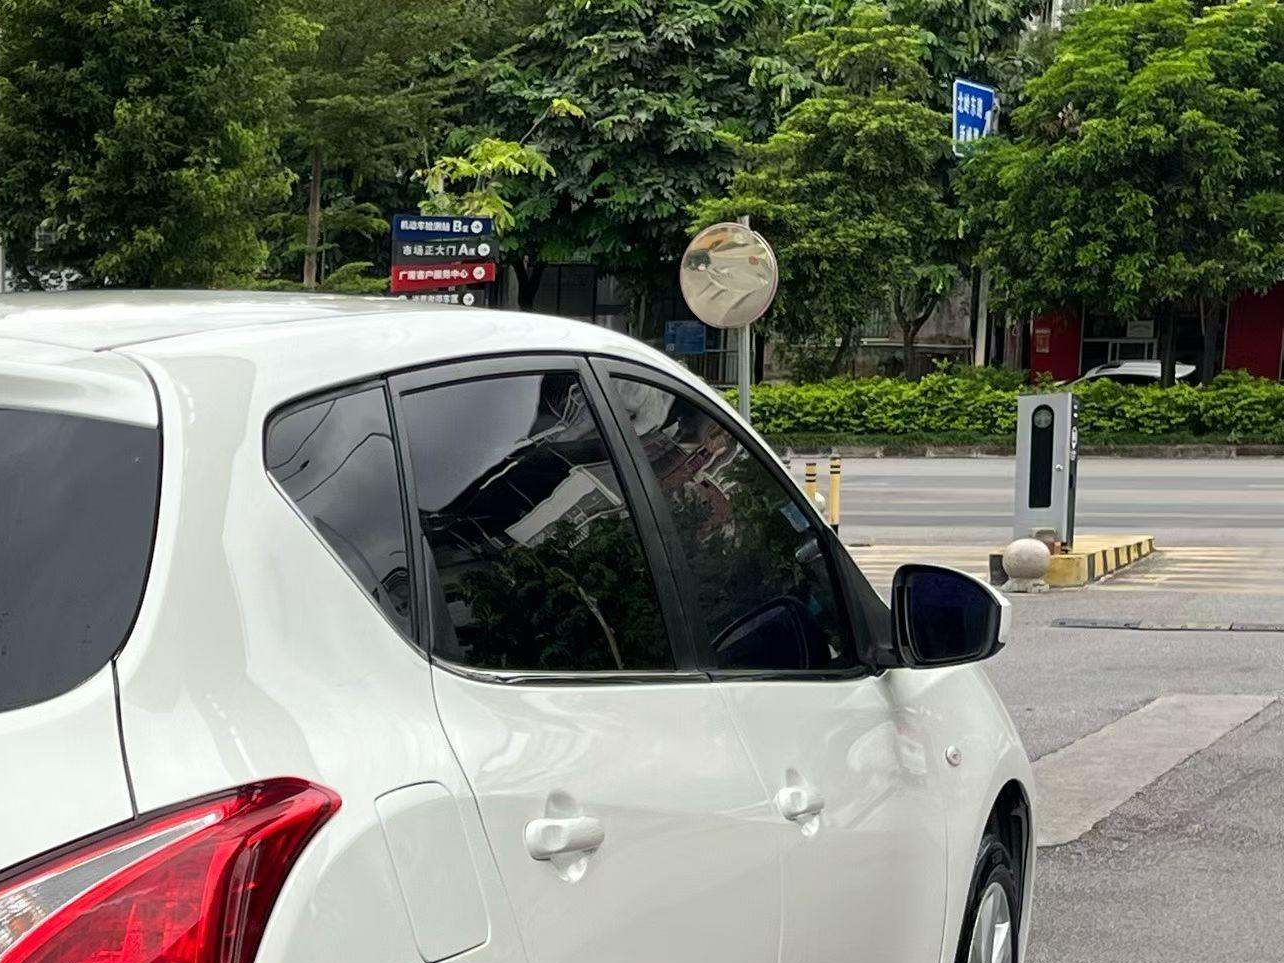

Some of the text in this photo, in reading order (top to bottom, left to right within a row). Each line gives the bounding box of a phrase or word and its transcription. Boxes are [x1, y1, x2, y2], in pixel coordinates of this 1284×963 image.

[402, 245, 456, 256] 市场正大门
